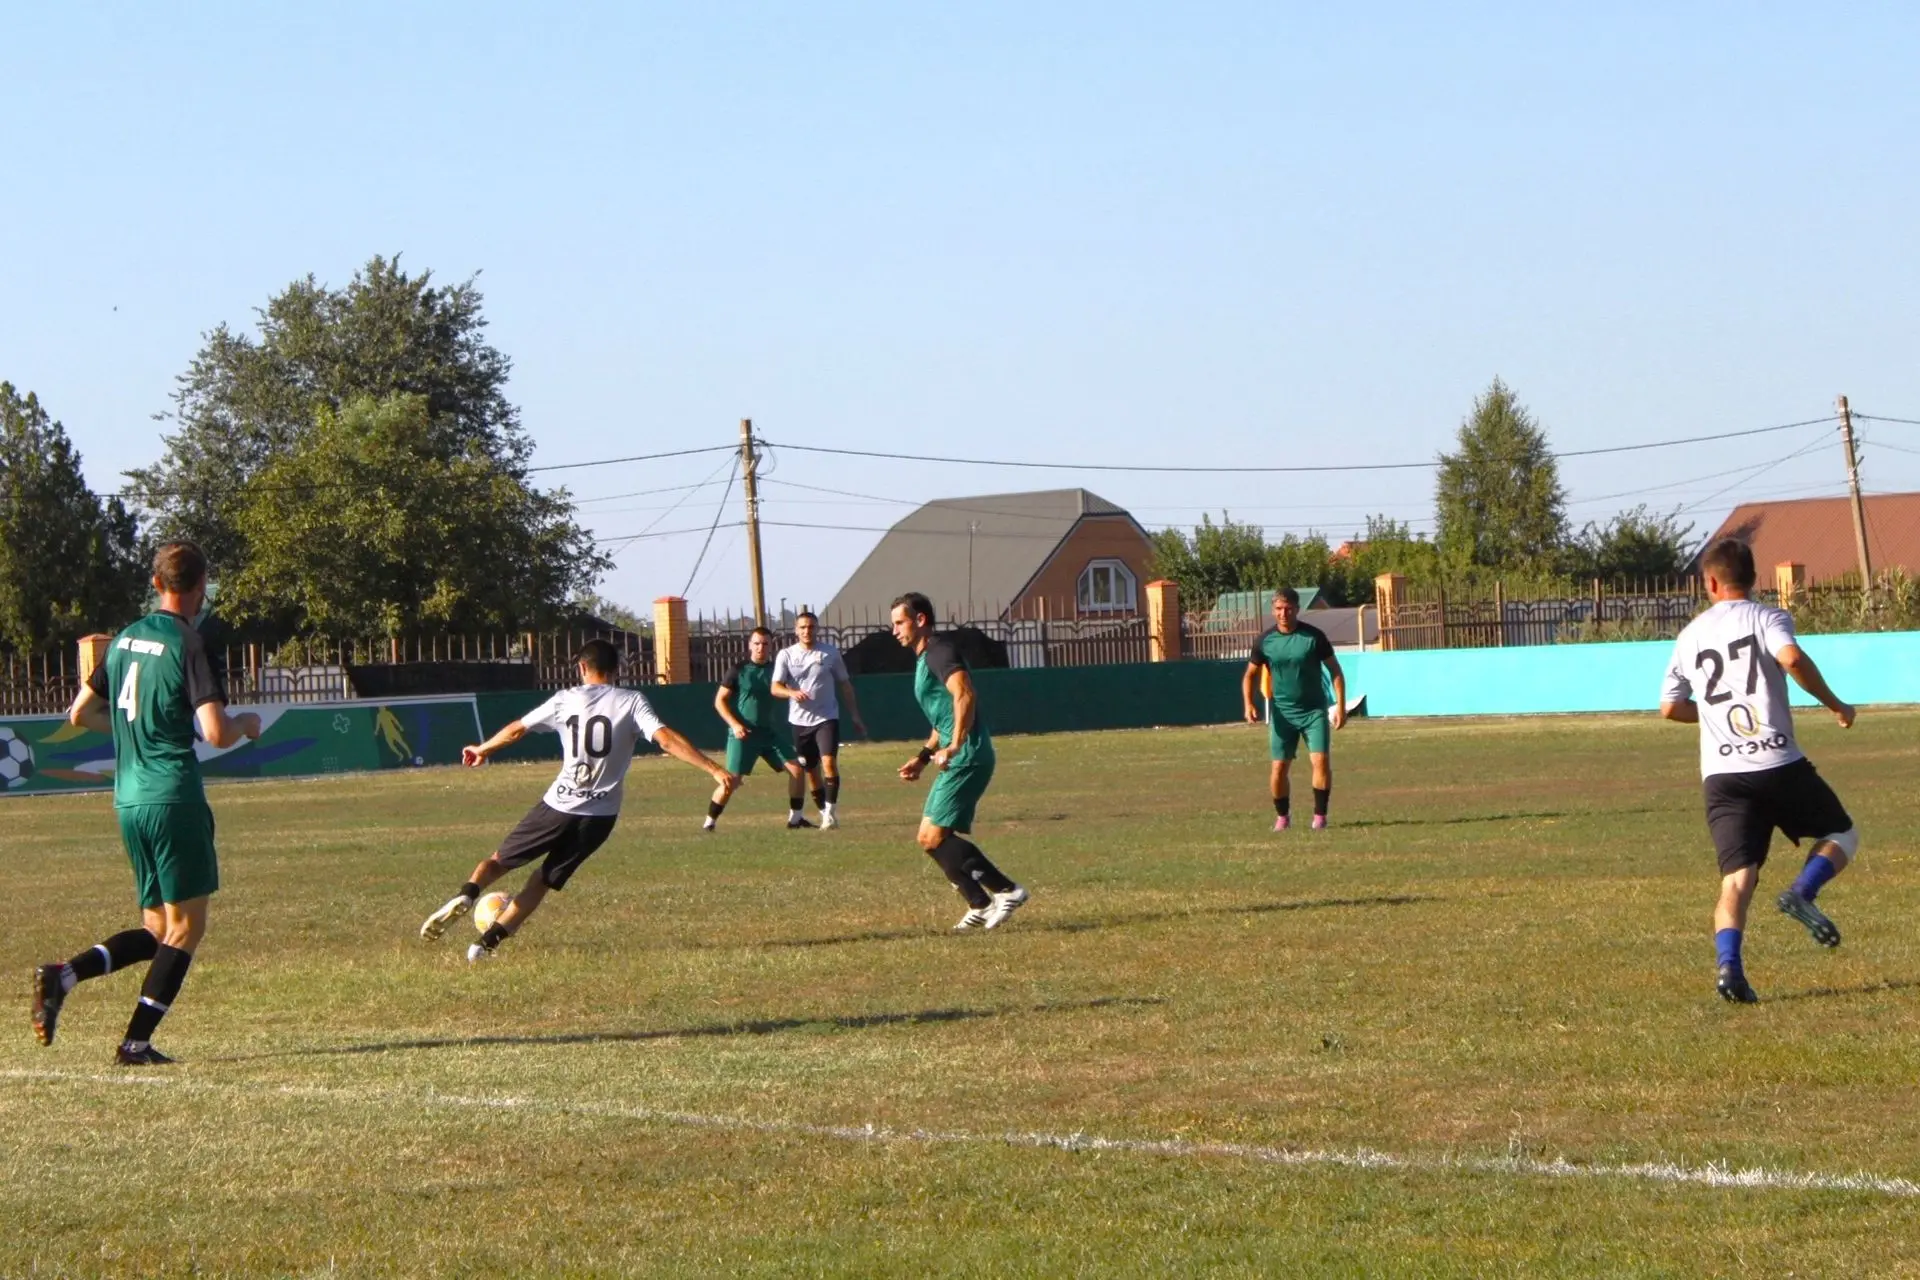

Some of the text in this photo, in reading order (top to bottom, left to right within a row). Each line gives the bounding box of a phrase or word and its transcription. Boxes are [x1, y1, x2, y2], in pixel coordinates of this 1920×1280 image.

[118, 661, 138, 722] 4
[1696, 634, 1758, 706] 27
[566, 715, 612, 758] 10
